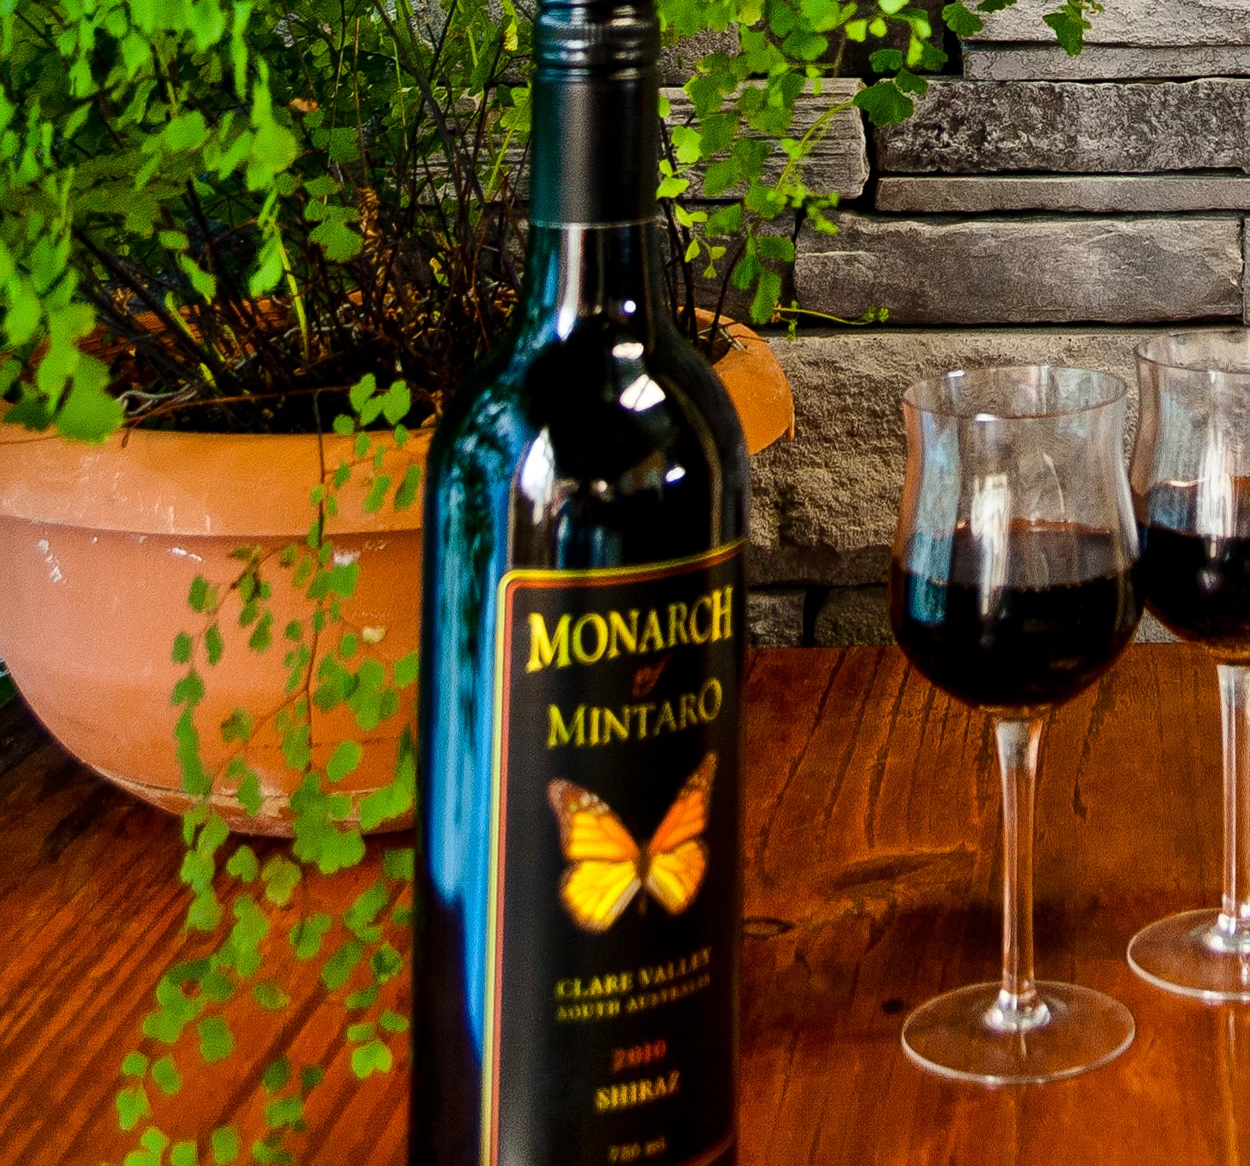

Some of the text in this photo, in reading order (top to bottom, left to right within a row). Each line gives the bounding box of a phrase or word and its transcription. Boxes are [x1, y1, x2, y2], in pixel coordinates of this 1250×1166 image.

[526, 585, 734, 673] MONARCH
[547, 678, 723, 749] MINTARO
[554, 970, 633, 1000] CLARE
[594, 1069, 681, 1113] SHIRAZ
